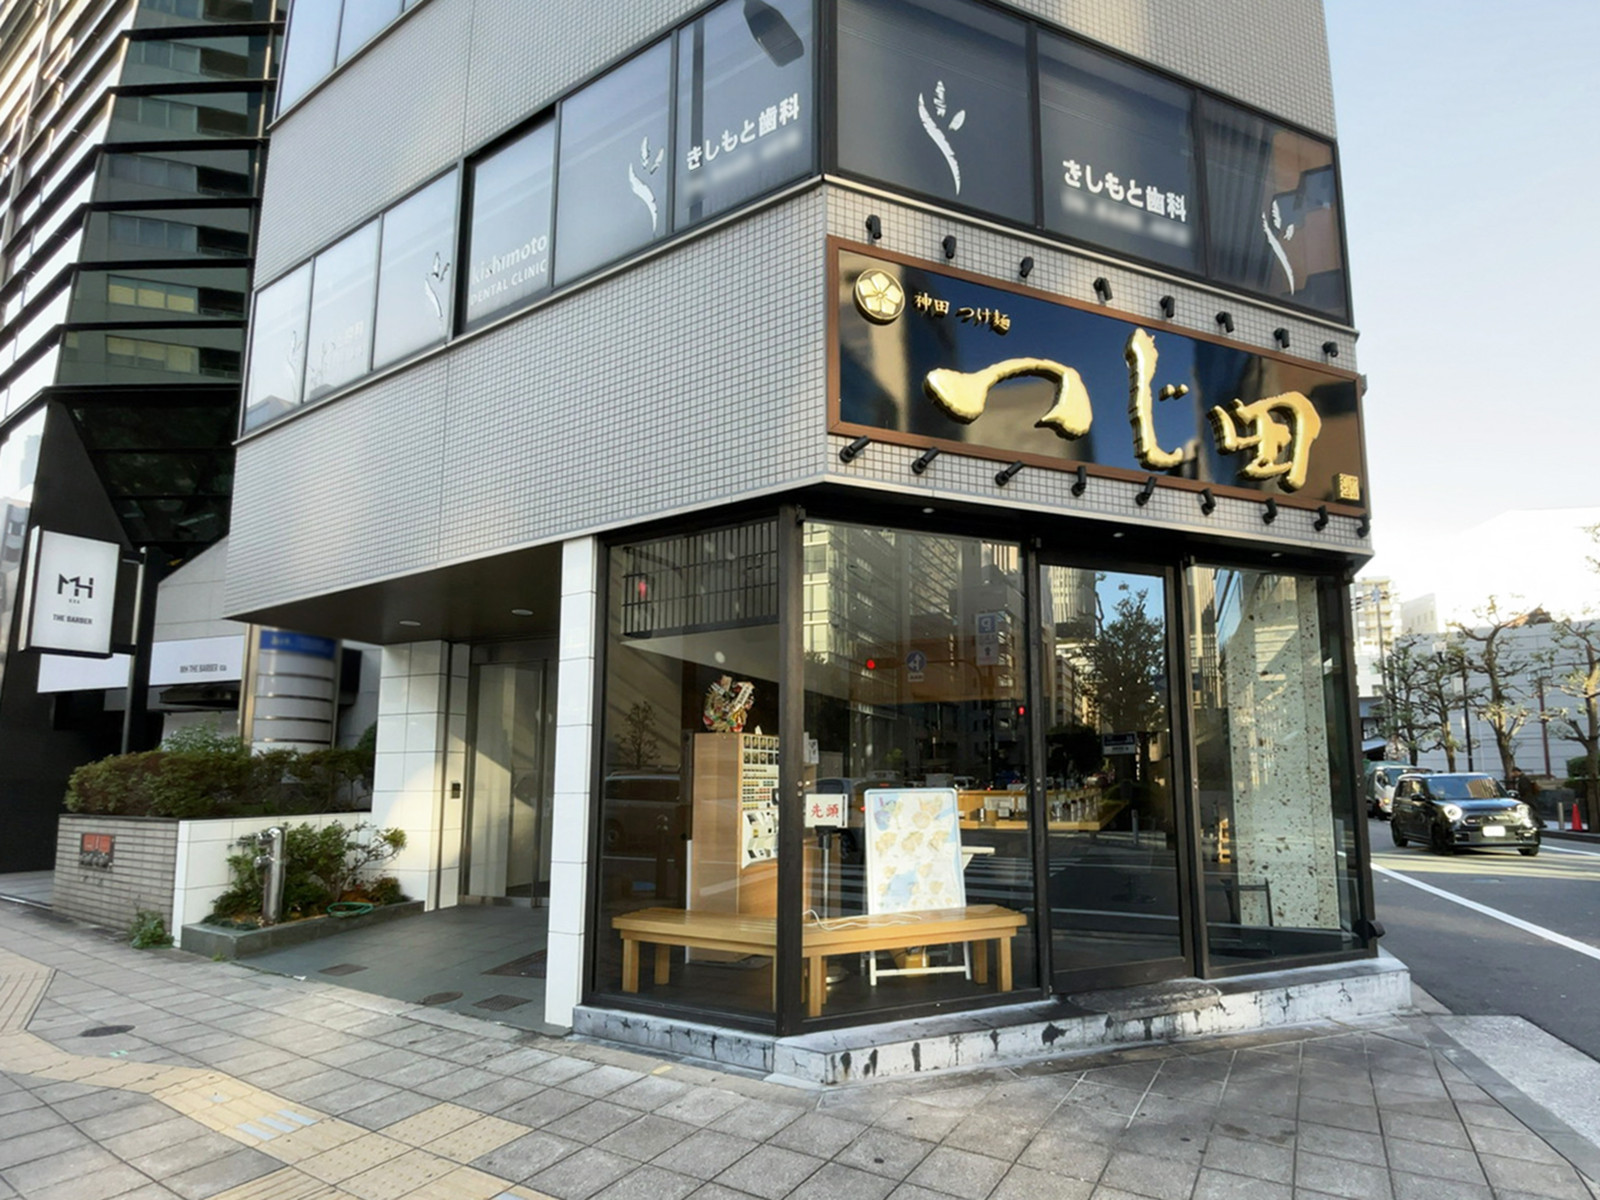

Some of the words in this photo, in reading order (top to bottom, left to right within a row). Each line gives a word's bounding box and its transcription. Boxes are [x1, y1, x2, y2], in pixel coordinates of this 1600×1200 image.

[686, 93, 800, 171] きしもと歯科
[1062, 160, 1188, 223] きしもと歯科
[511, 258, 547, 286] CLINIC
[914, 292, 950, 313] 神田
[957, 306, 1011, 332] つけ麺
[922, 327, 1322, 494] つじ田
[53, 613, 65, 622] THE
[66, 615, 93, 625] BARBER
[811, 803, 840, 819] 先頭
